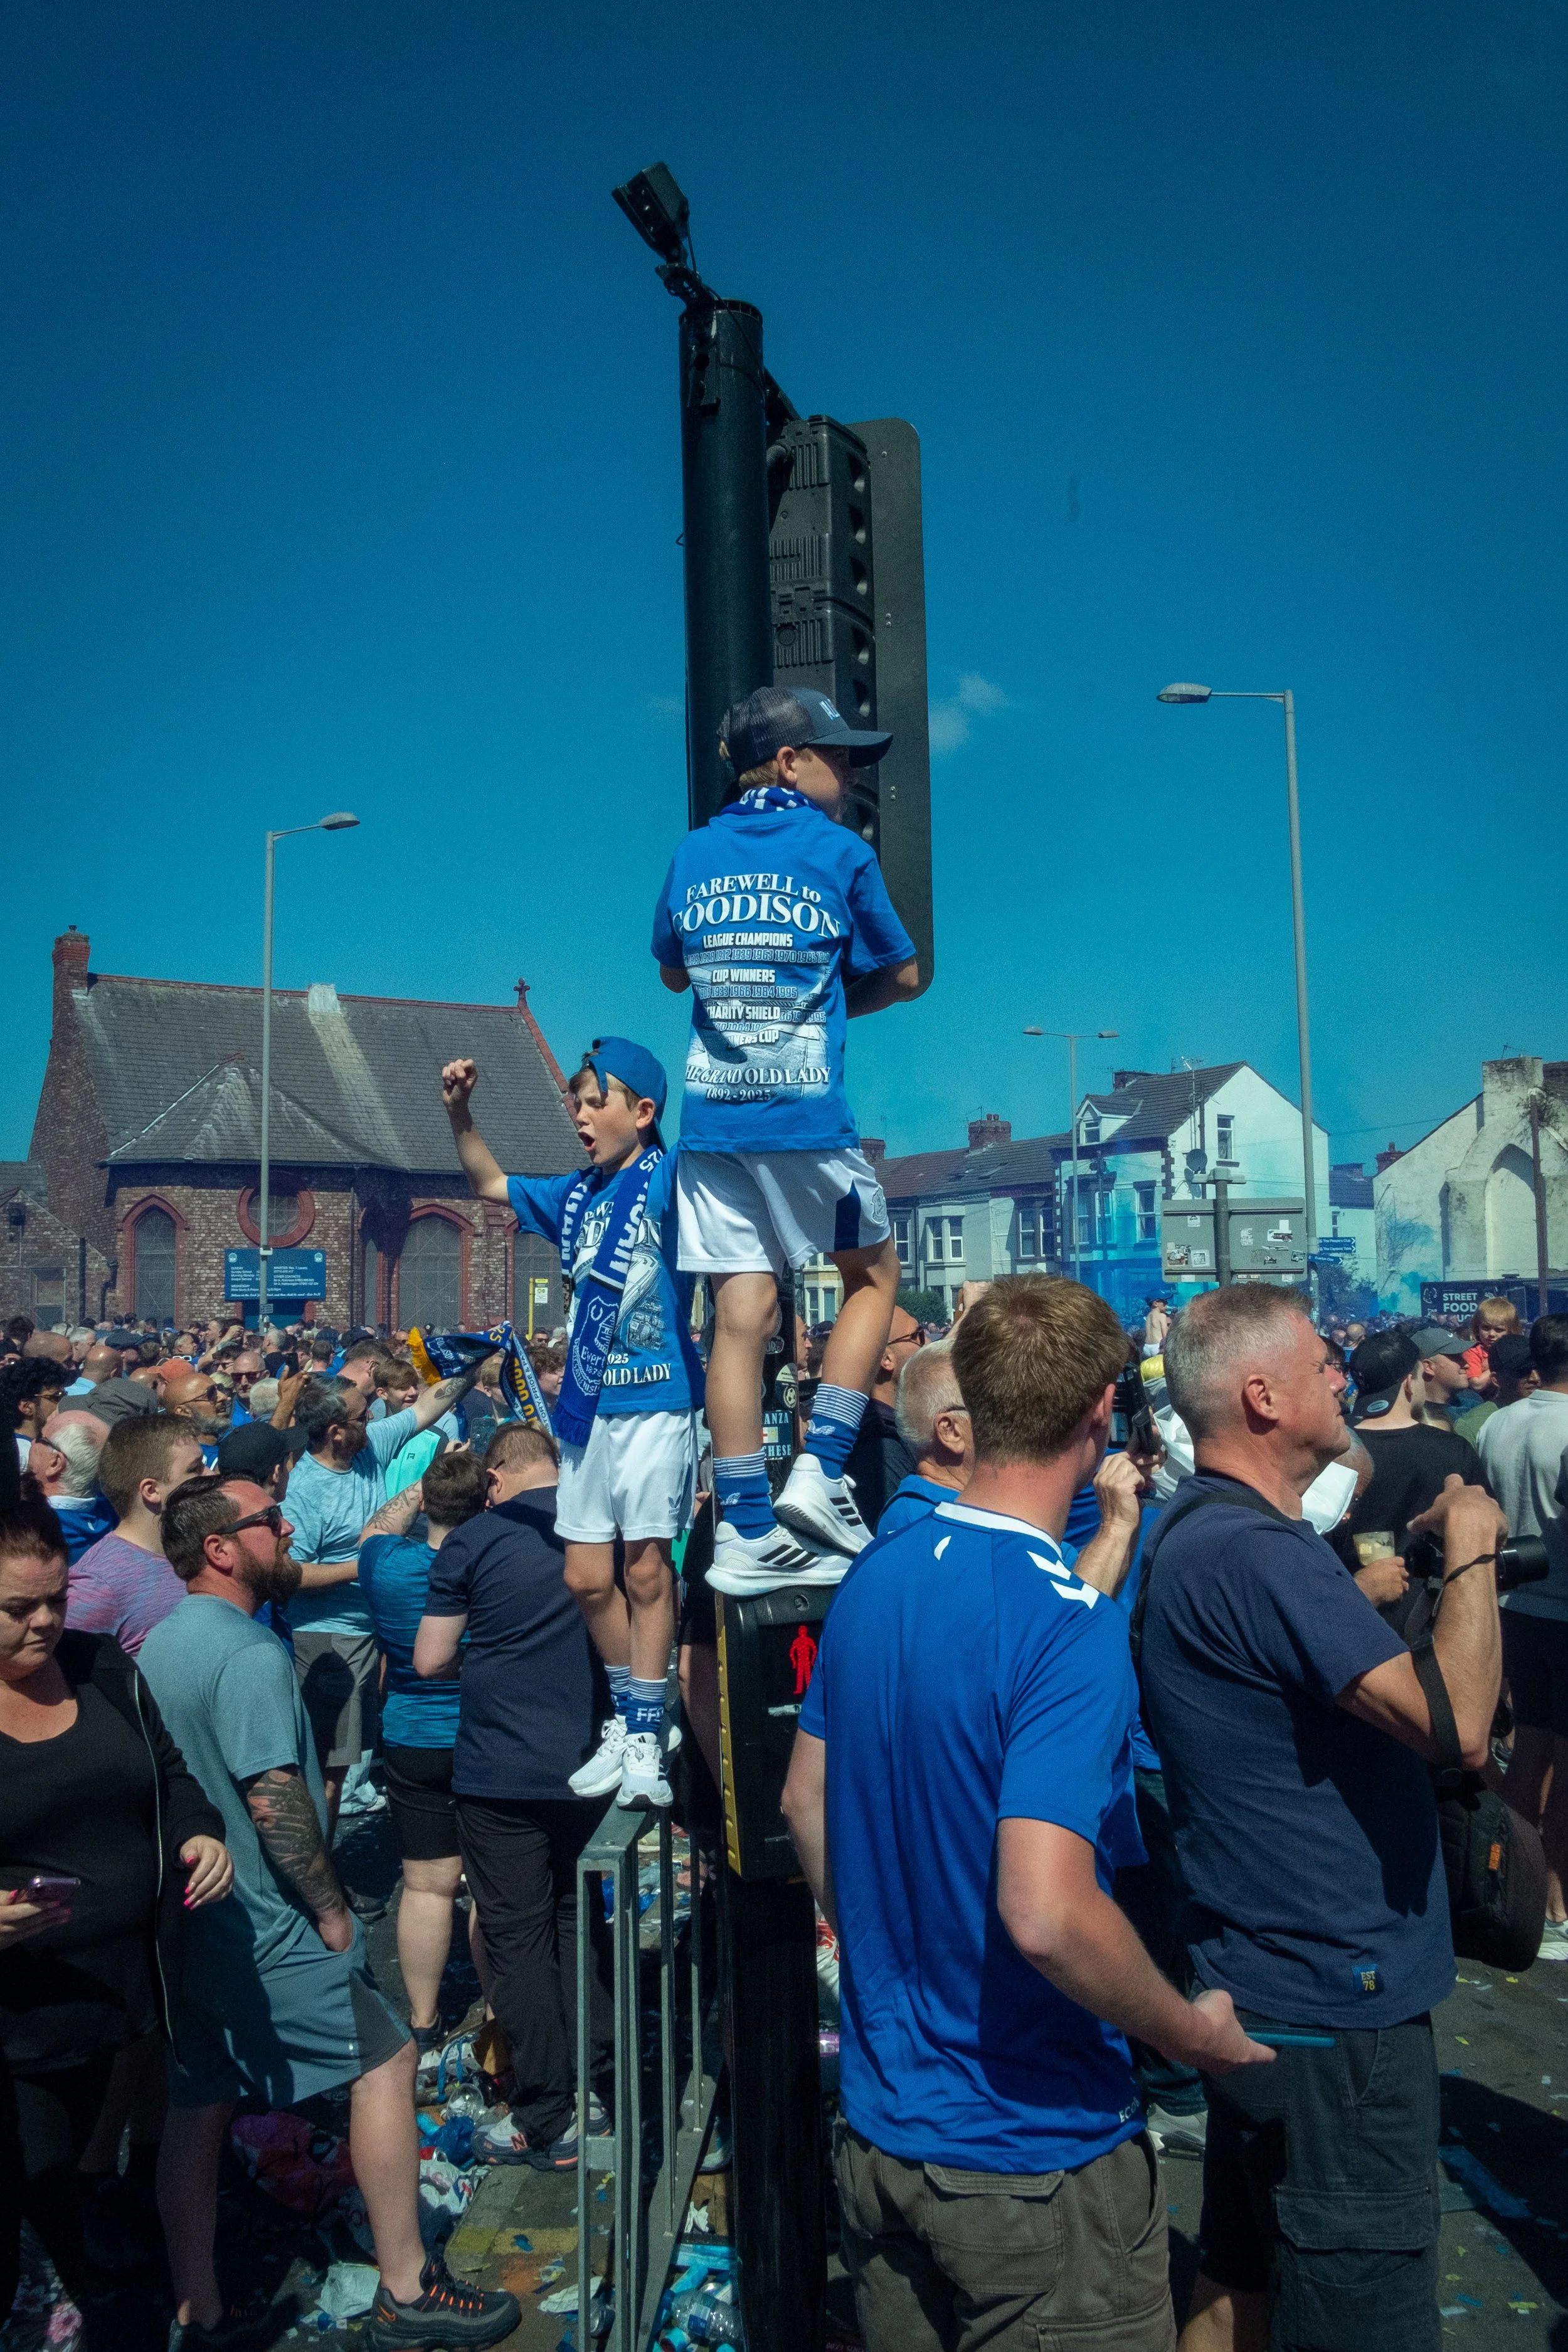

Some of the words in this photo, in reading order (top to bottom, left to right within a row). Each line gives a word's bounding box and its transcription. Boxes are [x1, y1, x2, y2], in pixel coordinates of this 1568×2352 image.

[686, 873, 798, 905] FAREWELL
[802, 885, 822, 903] to
[703, 933, 734, 949] LEAGUE
[735, 933, 793, 947] CHAMPIONS
[731, 948, 752, 961] 1939
[752, 949, 773, 961] 1963
[775, 950, 796, 962] 1970
[797, 951, 816, 963] 1985
[712, 970, 728, 983] CUP
[730, 969, 775, 983] WINNERS
[711, 985, 729, 998] 1933
[729, 985, 751, 997] 1966
[752, 985, 775, 997] 1984
[775, 986, 797, 999] 1995
[745, 1006, 780, 1020] SHIELD
[759, 1030, 779, 1043] CUP
[686, 1064, 699, 1081] HE
[701, 1067, 743, 1084] GRAND
[744, 1067, 782, 1084] OLD
[785, 1066, 831, 1084] LADY
[706, 1088, 731, 1100] 1892
[739, 1089, 771, 1101] 2025
[1443, 1293, 1478, 1301] STREET
[1443, 1303, 1478, 1312] FOOD
[607, 1353, 629, 1365] 025
[603, 1369, 632, 1387] OLD
[633, 1363, 672, 1384] LADY
[1360, 1971, 1375, 1981] EST
[1362, 1980, 1375, 1991] 78
